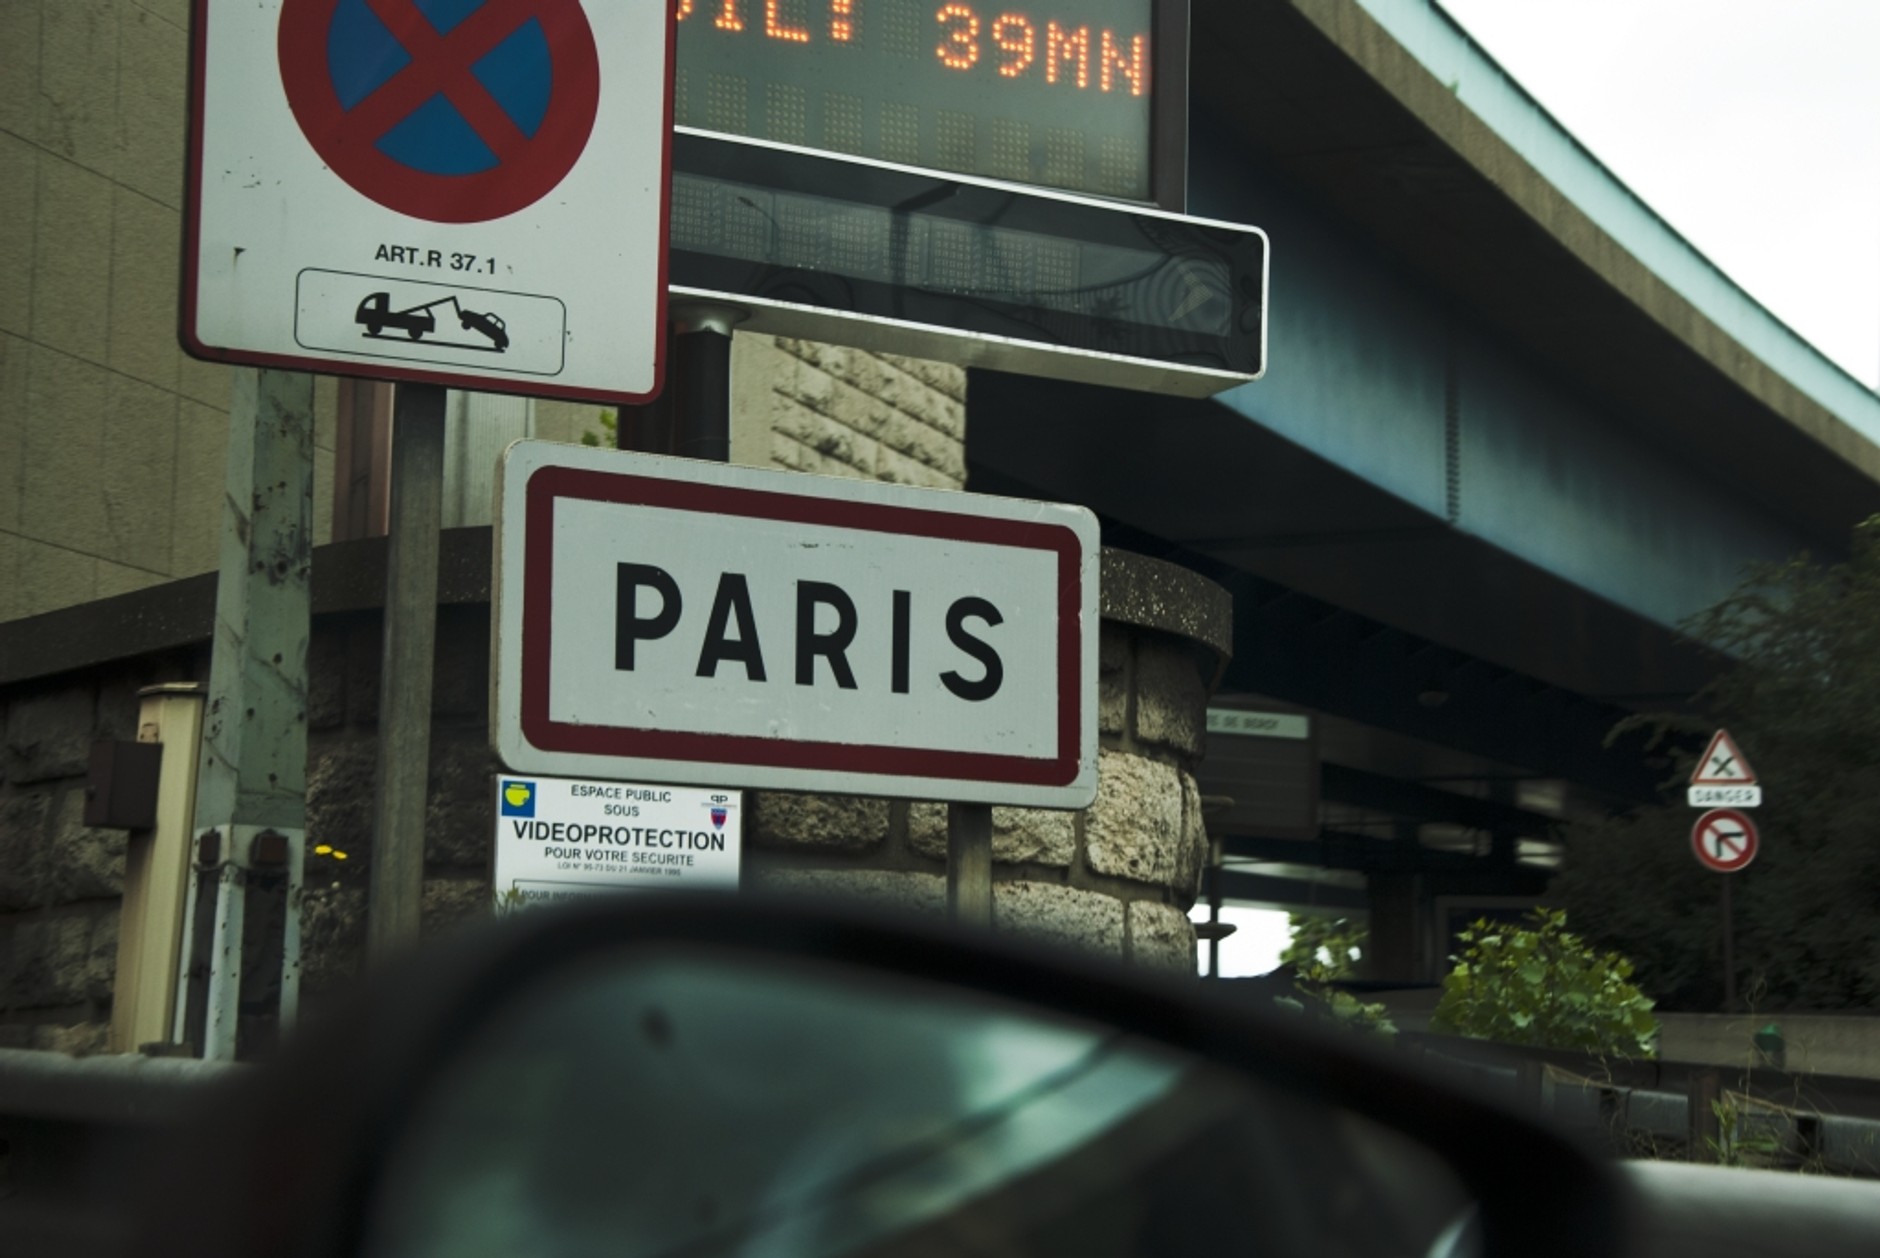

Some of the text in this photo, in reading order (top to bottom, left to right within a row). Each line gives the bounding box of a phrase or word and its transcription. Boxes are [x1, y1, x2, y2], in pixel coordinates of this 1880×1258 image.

[935, 3, 1142, 95] 39MN
[450, 252, 496, 275] 37.1
[614, 561, 1005, 702] PARIS
[570, 784, 672, 803] ESPACE PUBLIC
[603, 803, 640, 817] SOUS
[512, 820, 725, 851] VIDEOPROTECTION
[544, 846, 694, 867] POUR VOTRE SECURITE
